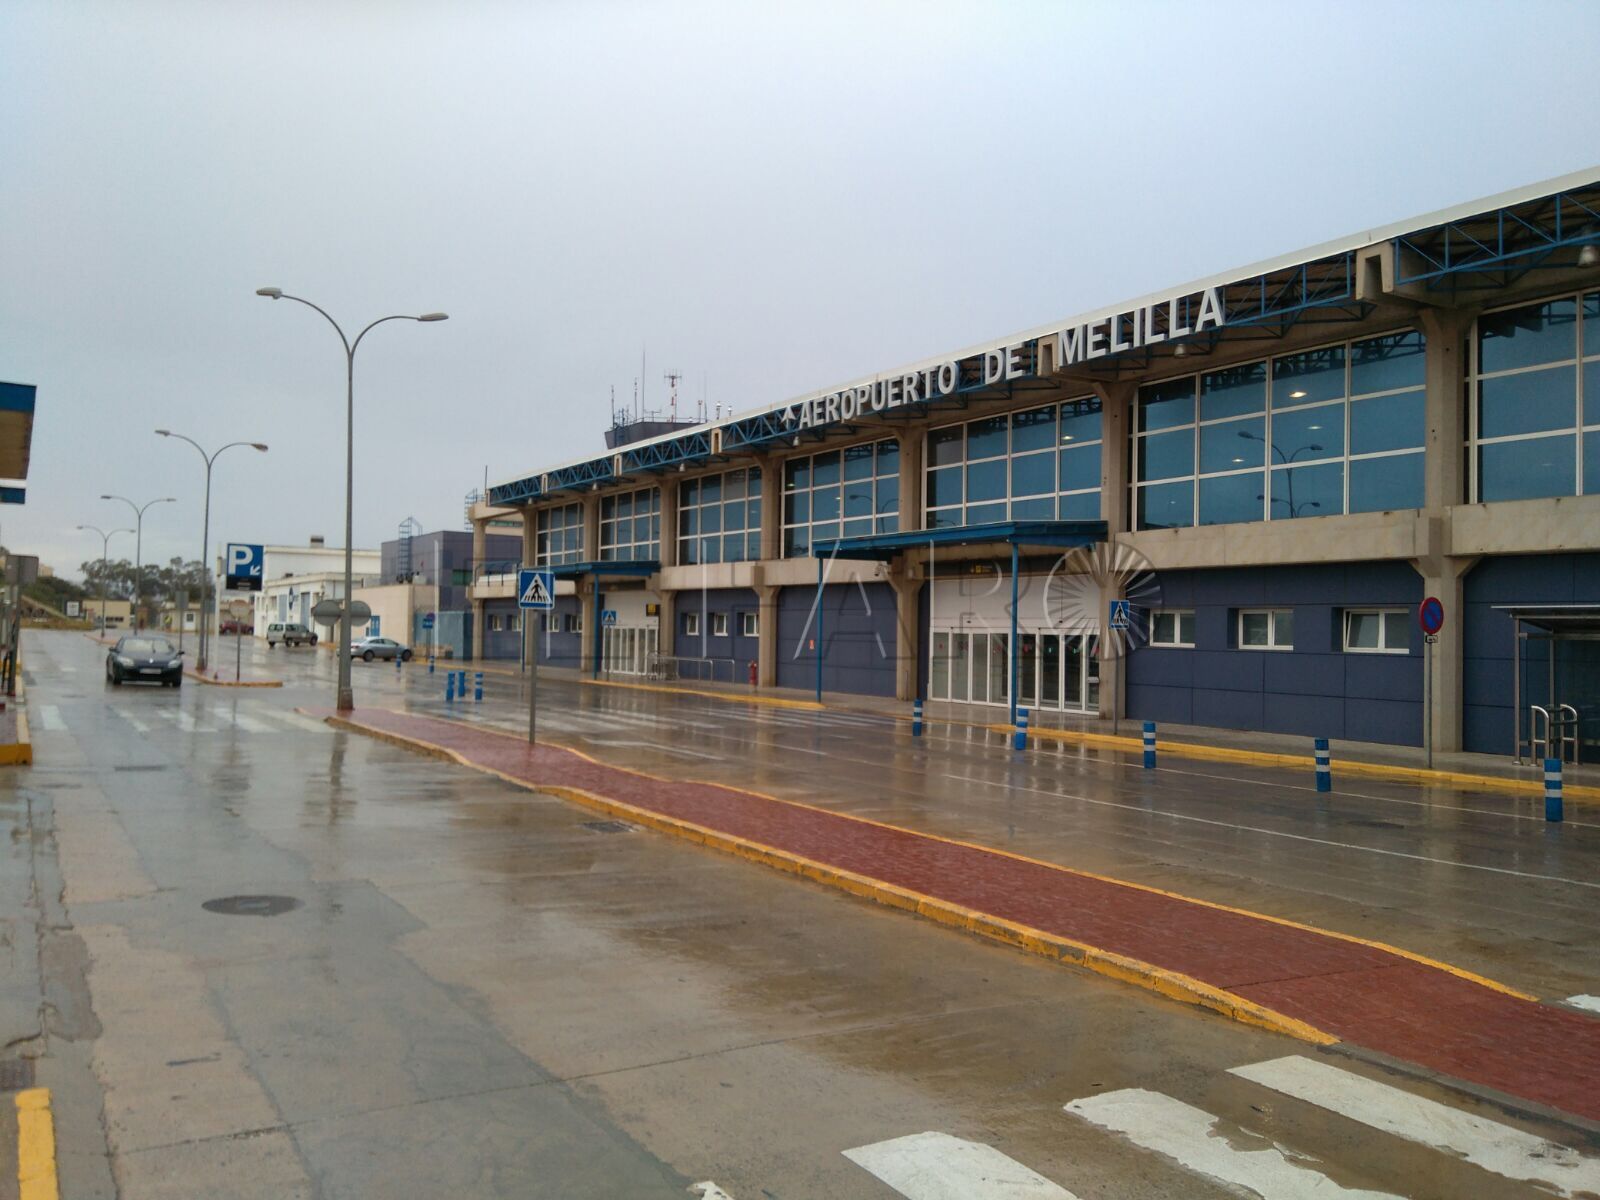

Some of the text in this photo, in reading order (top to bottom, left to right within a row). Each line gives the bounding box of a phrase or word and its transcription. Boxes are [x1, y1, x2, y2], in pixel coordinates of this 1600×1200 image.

[799, 287, 1225, 429] AEROPUERTO DE MELILLA
[228, 545, 254, 575] P
